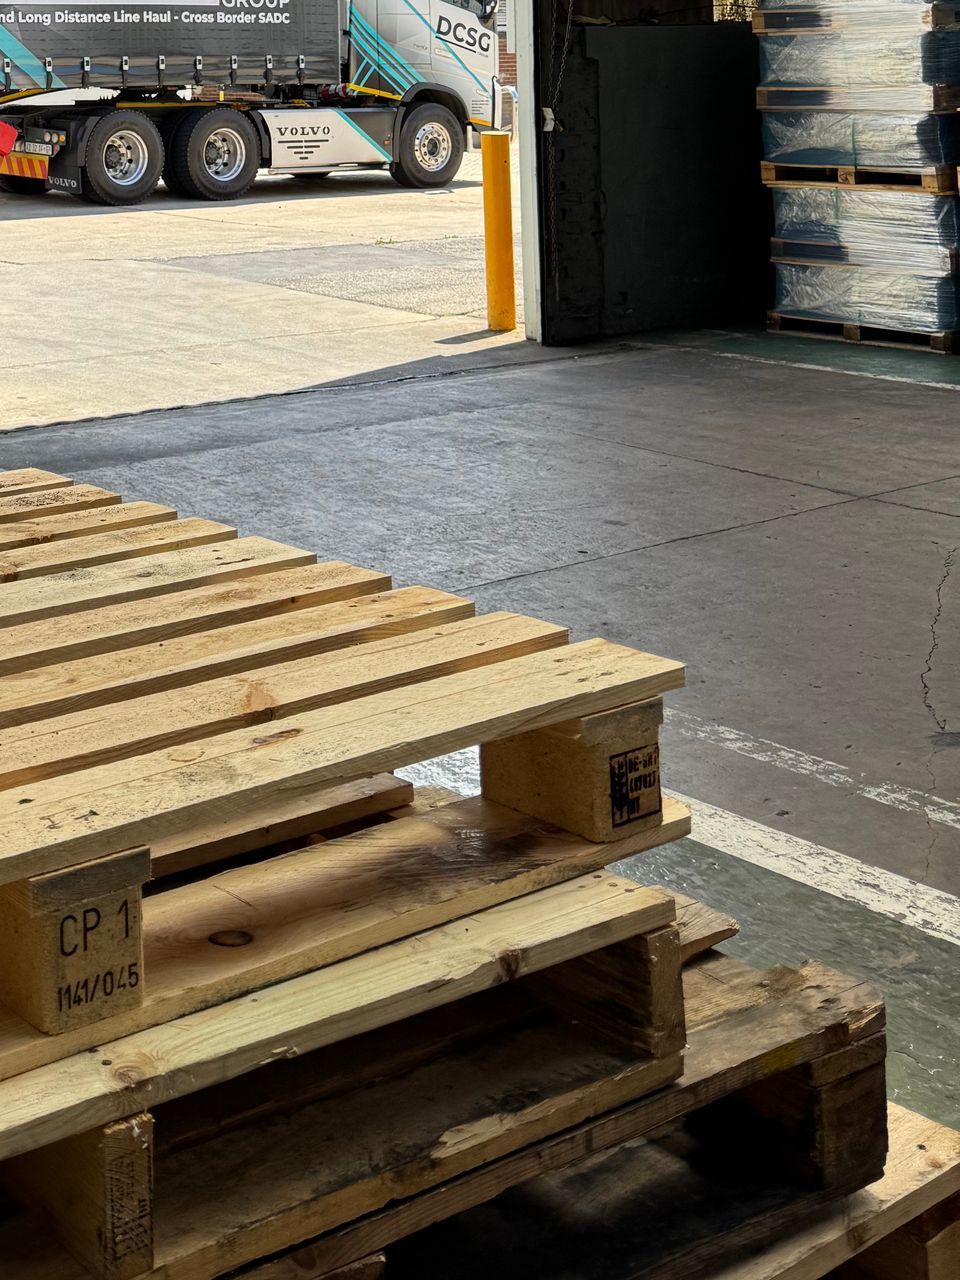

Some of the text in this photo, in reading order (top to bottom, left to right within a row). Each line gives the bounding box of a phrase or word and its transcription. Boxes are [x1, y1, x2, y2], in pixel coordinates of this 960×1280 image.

[18, 11, 51, 26] Long
[54, 10, 111, 24] Distance
[113, 10, 140, 23] Line
[143, 10, 171, 23] Haul
[181, 11, 215, 24] Cross
[216, 11, 257, 24] Border
[258, 12, 291, 24] SADC
[436, 15, 491, 53] DCSG
[276, 126, 331, 137] VOLVO
[48, 176, 78, 188] VOLVO
[59, 899, 130, 957] CP 1
